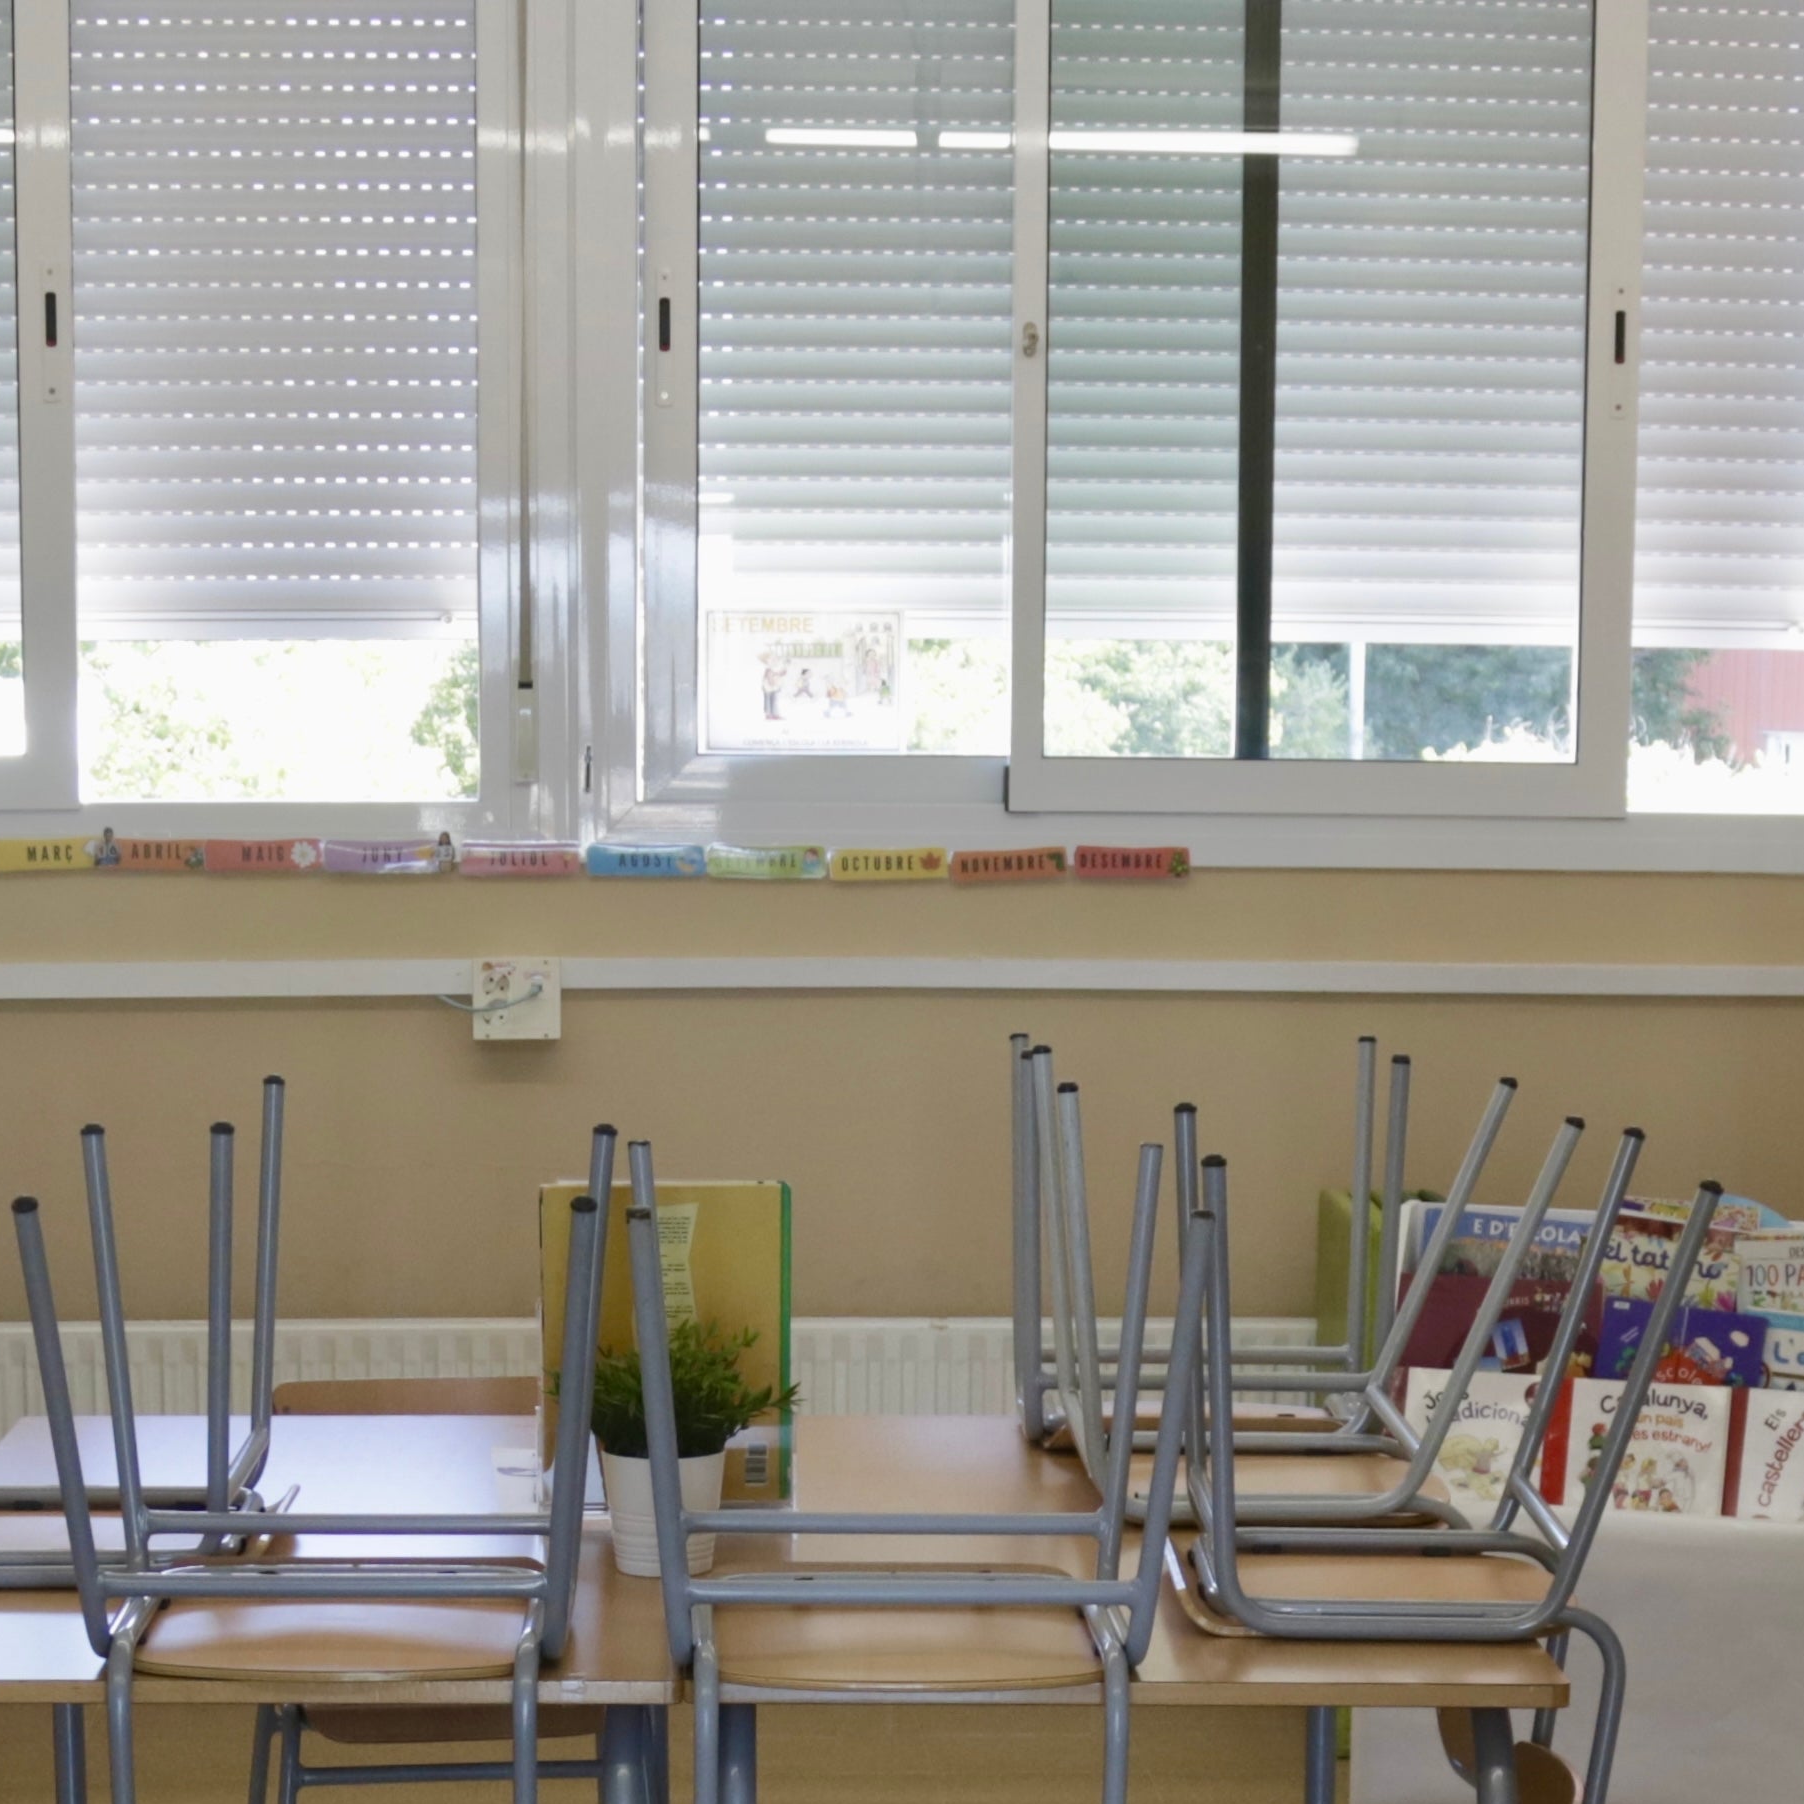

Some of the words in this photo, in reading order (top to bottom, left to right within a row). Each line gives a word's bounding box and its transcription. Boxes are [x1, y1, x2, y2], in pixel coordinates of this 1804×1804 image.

[713, 616, 814, 633] ETEMBRE
[26, 845, 74, 864] MARÇ
[131, 842, 181, 861] ABRIL
[241, 845, 285, 863] MAIG
[618, 852, 673, 867] AGOST
[1079, 853, 1163, 869] DESEMBRE
[841, 855, 915, 872] OCTUBRE
[960, 853, 1045, 873] NOVEMBRE
[1745, 1264, 1780, 1287] 100
[1600, 1389, 1709, 1420] Calunya,
[1763, 1408, 1787, 1431] Els
[1651, 1430, 1713, 1453] estrany!
